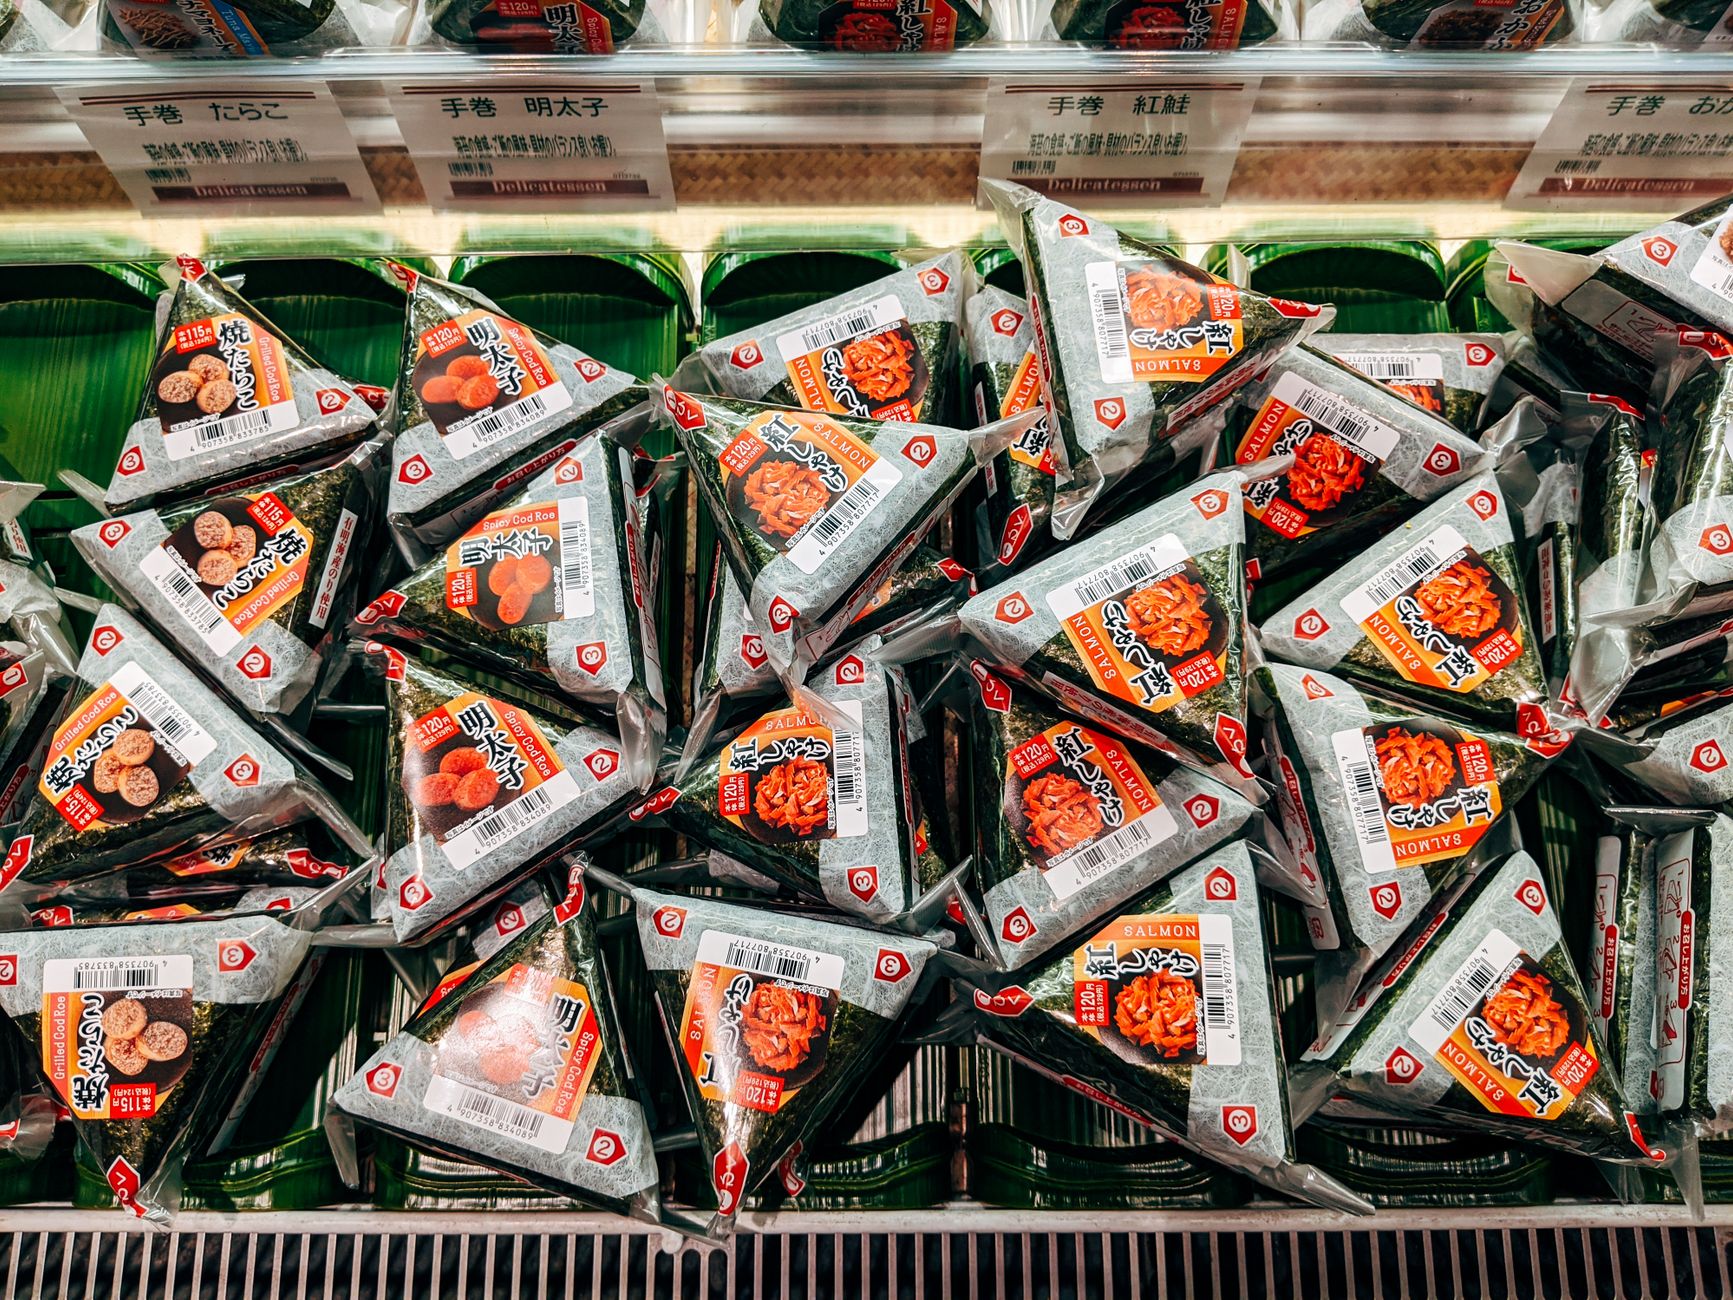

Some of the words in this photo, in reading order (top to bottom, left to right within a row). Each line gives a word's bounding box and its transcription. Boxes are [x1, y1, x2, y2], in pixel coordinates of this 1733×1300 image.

[933, 17, 947, 51] SALM
[123, 104, 183, 126] 手巻
[208, 102, 288, 121] たらこ
[441, 96, 497, 118] 手巻
[524, 96, 608, 117] 明太子
[1048, 95, 1104, 116] 手巻
[1132, 94, 1190, 115] 紅鮭
[1606, 96, 1666, 117] 手巻
[492, 180, 607, 194] Delicatessen
[1047, 178, 1161, 191] Delicatessen
[256, 335, 274, 365] Grilled
[466, 318, 525, 394] 明太子
[1130, 320, 1234, 355] 紅しゃけ
[219, 319, 258, 410] 焼たらこ
[506, 327, 527, 352] Spicy
[521, 349, 540, 369] Cod
[531, 367, 548, 387] Roe
[1135, 359, 1200, 372] SALMON
[265, 366, 279, 386] Cod
[269, 383, 283, 402] Roe
[1010, 360, 1040, 415] SALMO
[810, 422, 872, 469] SALMON
[1243, 401, 1285, 463] SALMON
[759, 413, 846, 492] 紅しゃけ
[1243, 419, 1312, 508] 紅ゃけ
[483, 518, 511, 531] Spicy
[512, 512, 533, 525] Cod
[535, 511, 556, 522] Roe
[461, 528, 552, 565] 明太子
[212, 527, 306, 610] 焼たらこ
[267, 569, 299, 599] Grilled
[316, 516, 356, 620] 有明海産のり使用
[233, 608, 254, 629] Roe
[248, 594, 270, 616] Cod
[1071, 615, 1119, 679] SALMON
[1104, 600, 1173, 703] 紅しゃけ
[1368, 614, 1424, 670] SALMON
[1398, 596, 1477, 686] 紅しゃけ
[52, 721, 84, 752] Grilled
[81, 703, 103, 724] Cod
[97, 689, 118, 709] Roe
[766, 713, 832, 731] SALM
[44, 706, 139, 794] 焼たらこ
[457, 702, 526, 789] 明太子
[502, 710, 527, 739] Spicy
[520, 735, 542, 759] Cod
[533, 755, 552, 778] Roe
[729, 737, 830, 770] 紅しゃけ
[1054, 727, 1121, 827] 紅しゃけ
[1104, 748, 1153, 811] SALMON
[1387, 787, 1494, 829] 紅しゃけ
[1395, 831, 1463, 857] SALMON
[1123, 925, 1196, 937] SALMON
[1084, 942, 1198, 979] 紅しゃけ
[1679, 923, 1692, 996] お召し上がり方
[54, 996, 66, 1016] Roe
[53, 1016, 65, 1039] Cod
[54, 1043, 65, 1080] Grilled
[74, 995, 108, 1108] 焼たらこ
[573, 1031, 593, 1065] Spicy
[1466, 1017, 1561, 1114] 紅しゃけ
[562, 1065, 582, 1091] Cod
[1441, 1042, 1508, 1101] SALMON
[554, 1090, 573, 1114] Roe
